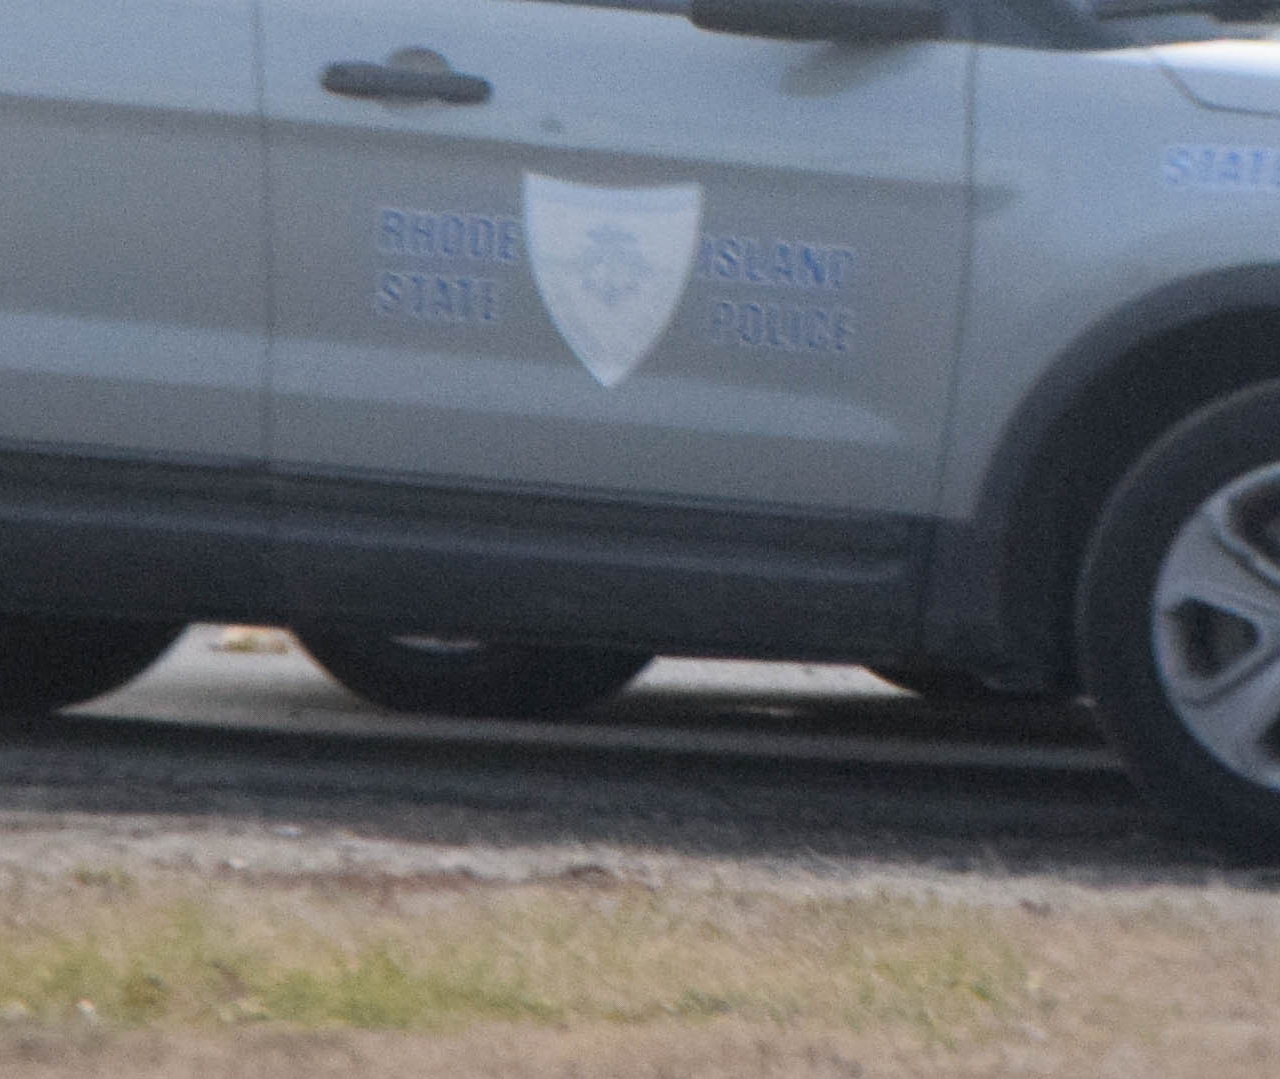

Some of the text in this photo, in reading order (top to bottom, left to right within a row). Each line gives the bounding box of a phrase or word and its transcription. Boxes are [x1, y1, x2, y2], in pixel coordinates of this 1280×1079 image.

[378, 208, 856, 291] RHODE ISLAND
[374, 269, 859, 354] STATE POLICE
